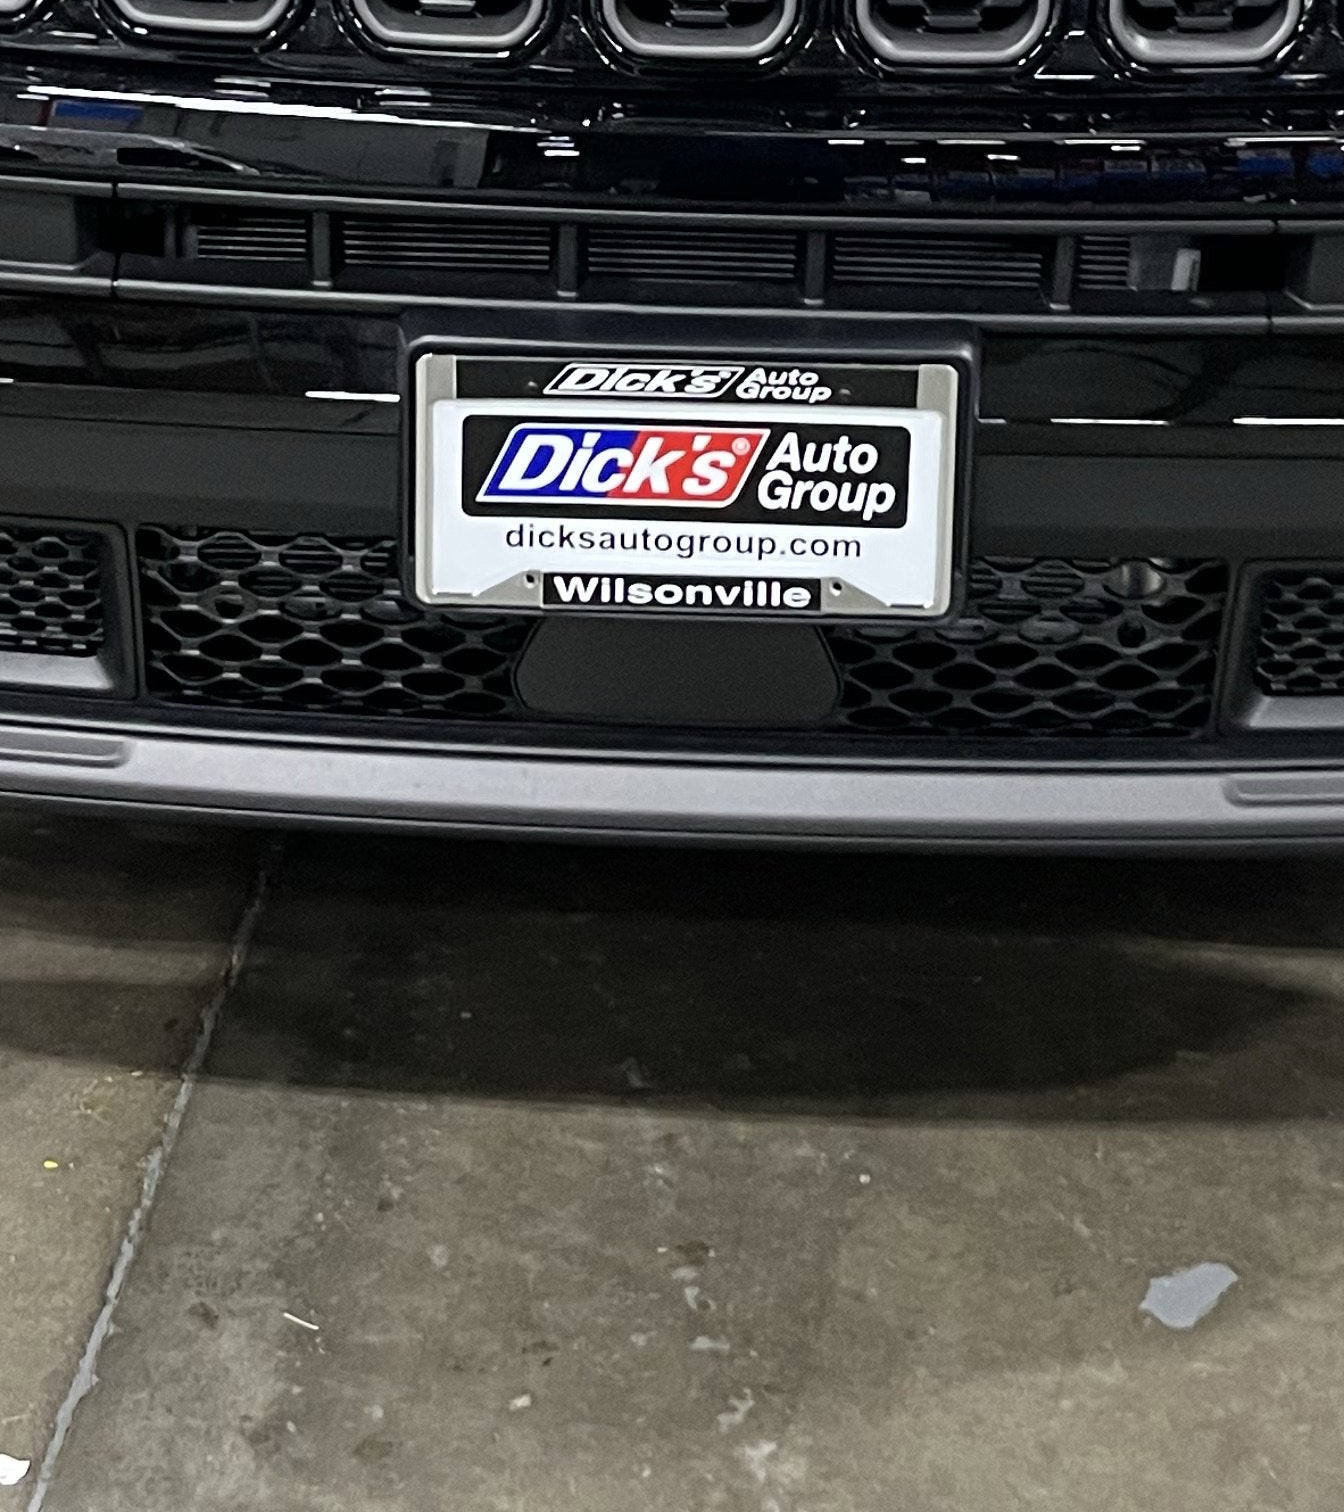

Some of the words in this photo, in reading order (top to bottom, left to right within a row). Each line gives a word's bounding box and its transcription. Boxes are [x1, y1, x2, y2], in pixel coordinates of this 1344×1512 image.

[748, 367, 819, 386] Auto
[736, 384, 832, 404] Group
[766, 432, 878, 474] Auto
[758, 471, 896, 520] Group
[506, 524, 861, 558] dicksautogroup.com
[554, 576, 811, 608] Wilsonville
